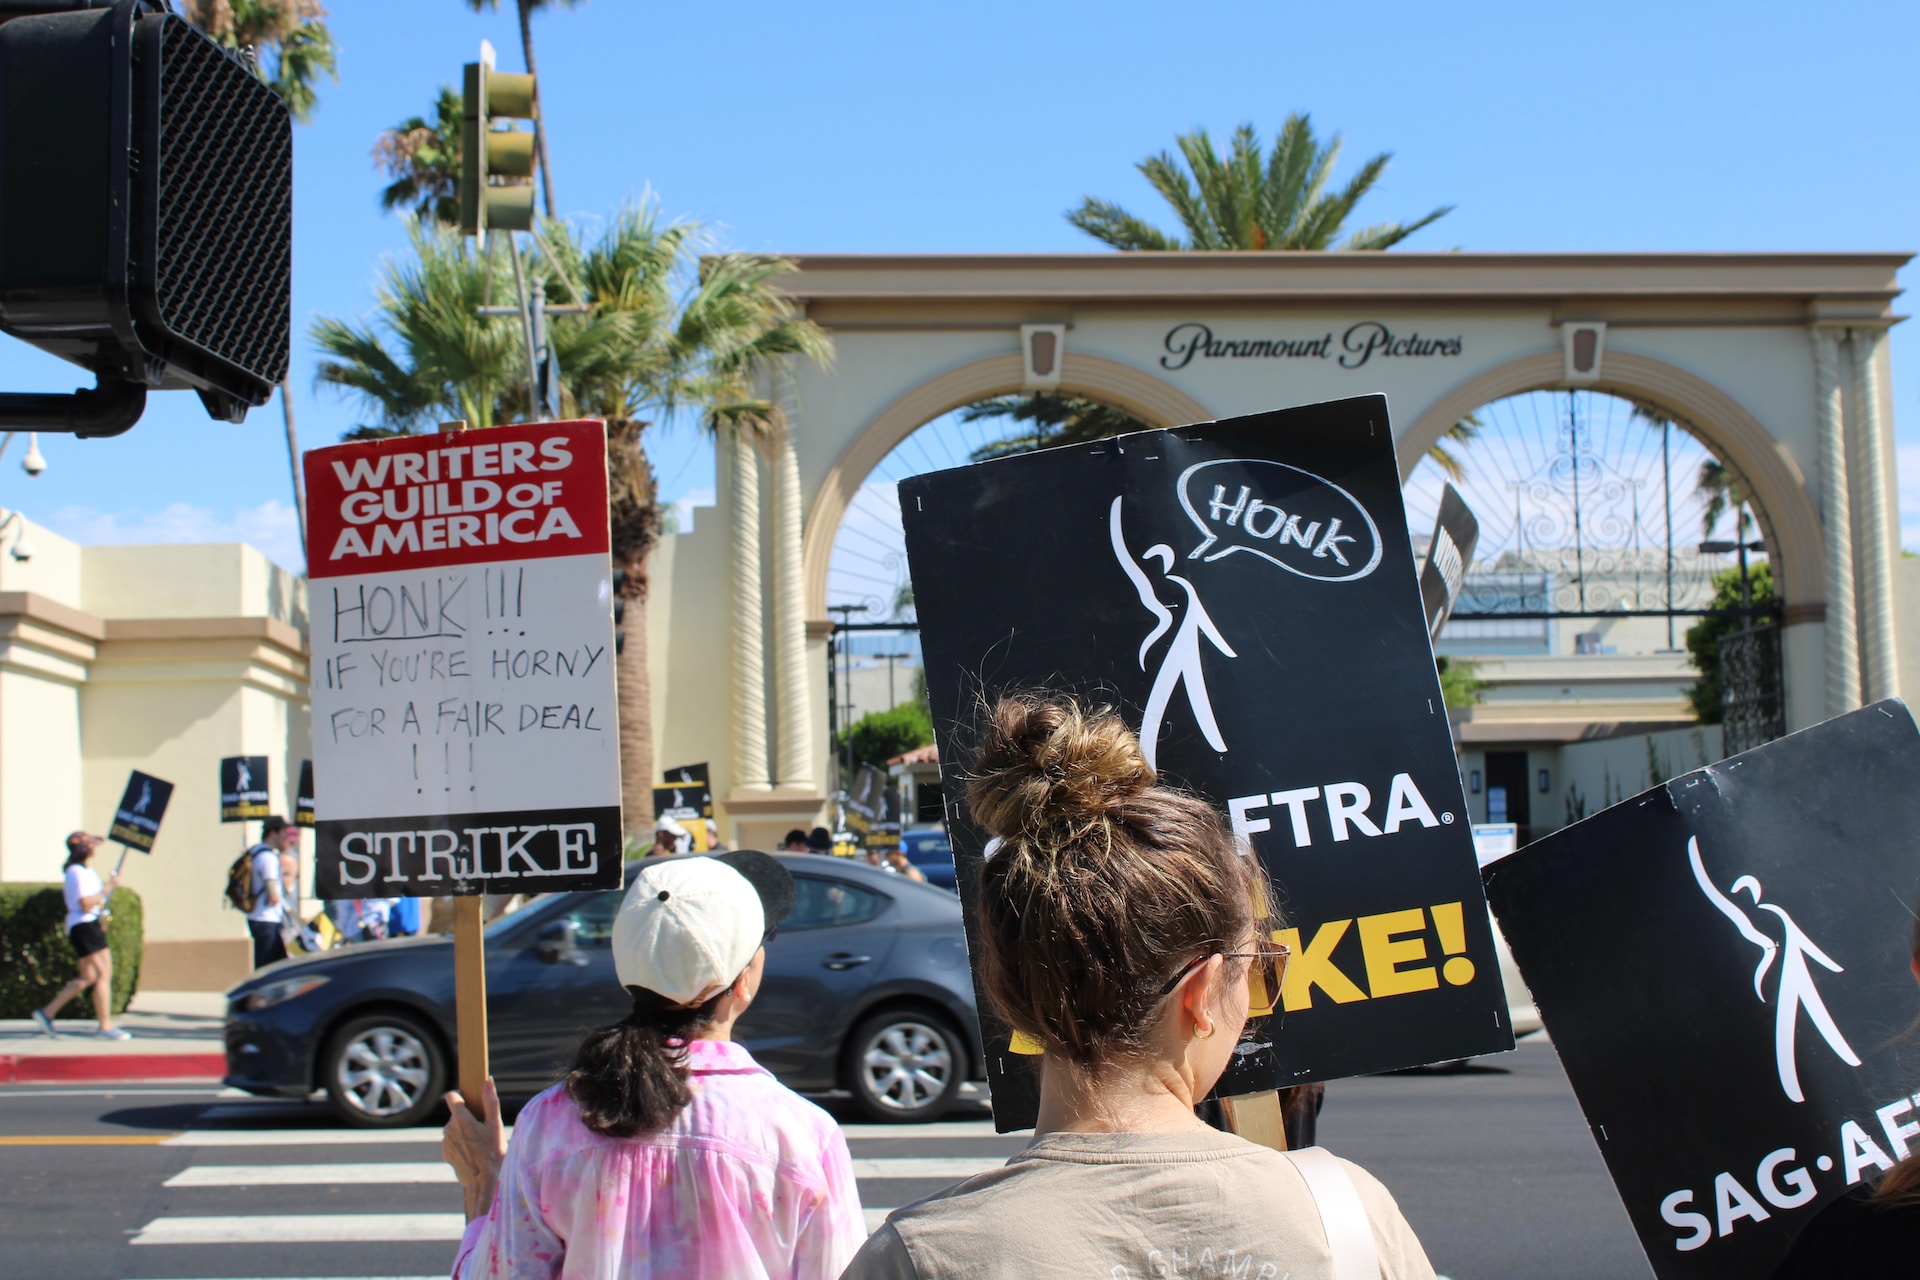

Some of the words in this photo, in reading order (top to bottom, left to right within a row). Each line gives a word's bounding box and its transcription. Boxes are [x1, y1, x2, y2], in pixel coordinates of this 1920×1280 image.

[1160, 322, 1332, 370] Paramount
[1338, 321, 1463, 369] Pictures
[331, 437, 573, 491] WRITERS
[340, 479, 502, 525] GUILD
[506, 481, 562, 508] OF
[1209, 484, 1357, 567] HONK
[329, 507, 583, 560] AMERICA
[326, 652, 357, 690] IF
[371, 650, 470, 688] YOU'RE
[492, 644, 604, 681] HORNY
[331, 707, 386, 744] FOR
[402, 701, 421, 735] A
[436, 697, 505, 737] FAIR
[519, 704, 602, 732] DEAL
[339, 822, 598, 886] STRIKE
